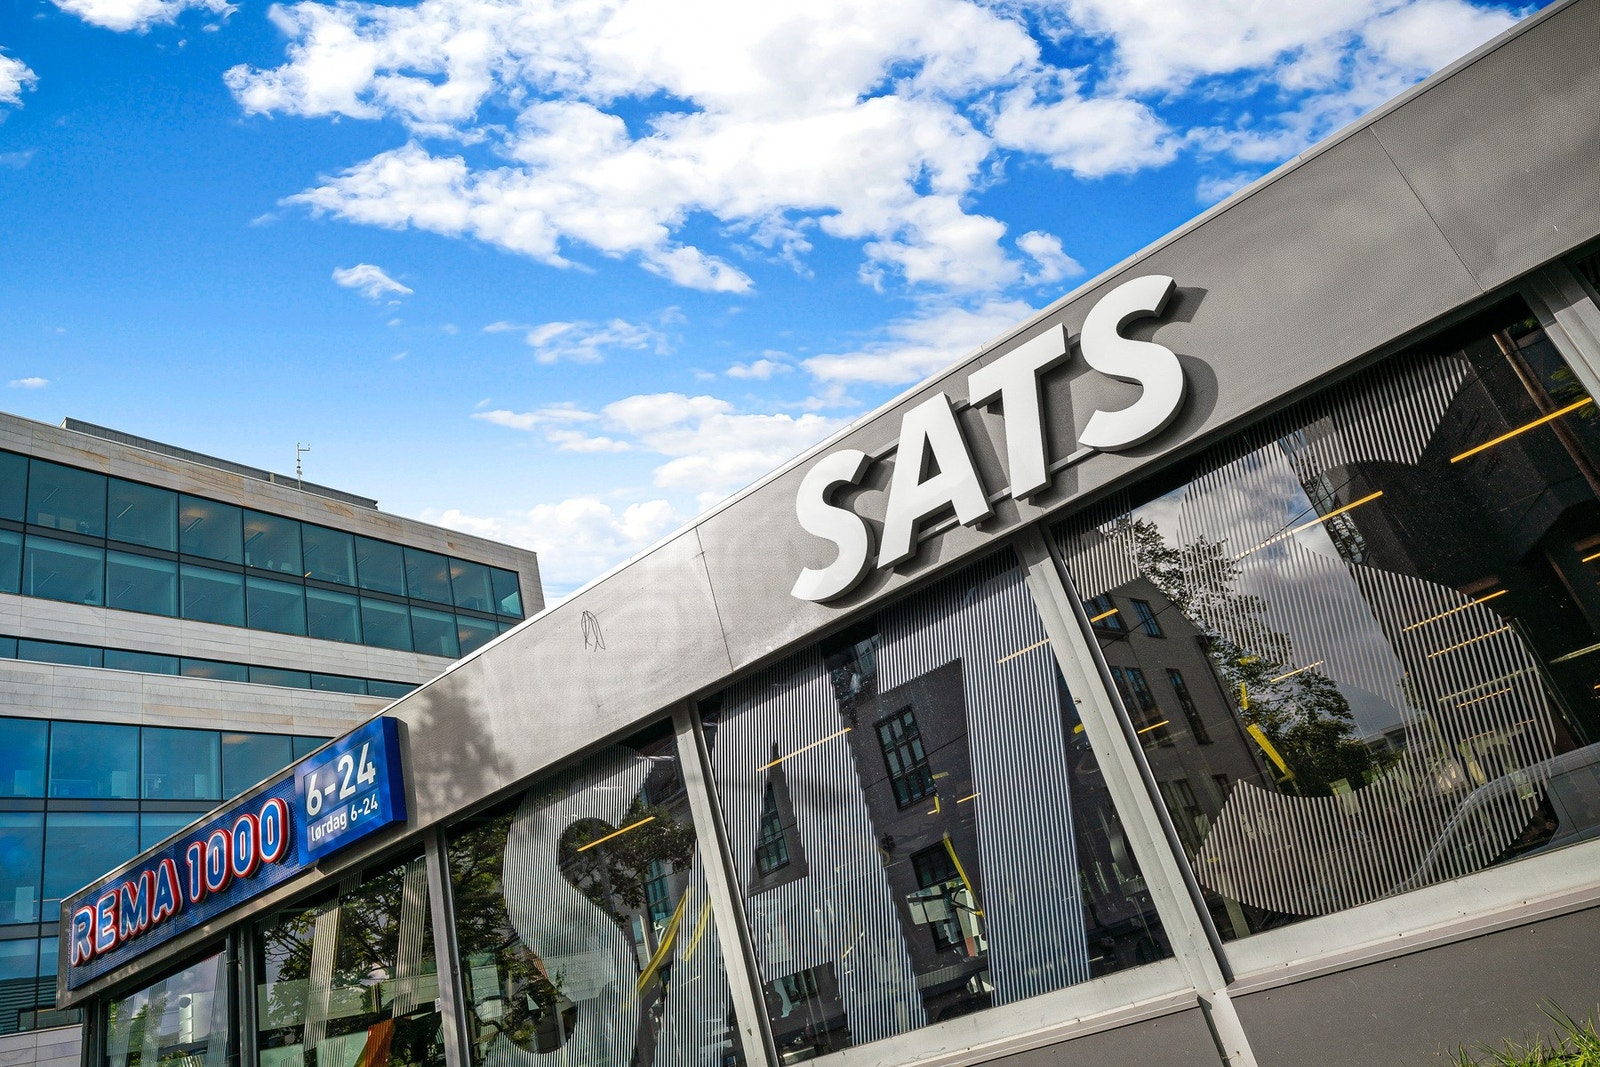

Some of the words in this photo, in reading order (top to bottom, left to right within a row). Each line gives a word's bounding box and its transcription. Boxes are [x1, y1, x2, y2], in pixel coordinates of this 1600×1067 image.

[790, 274, 1188, 604] SATS
[306, 742, 376, 816] 6-24
[350, 793, 378, 822] 6-24
[70, 857, 184, 967] REMA
[185, 797, 290, 904] 1000
